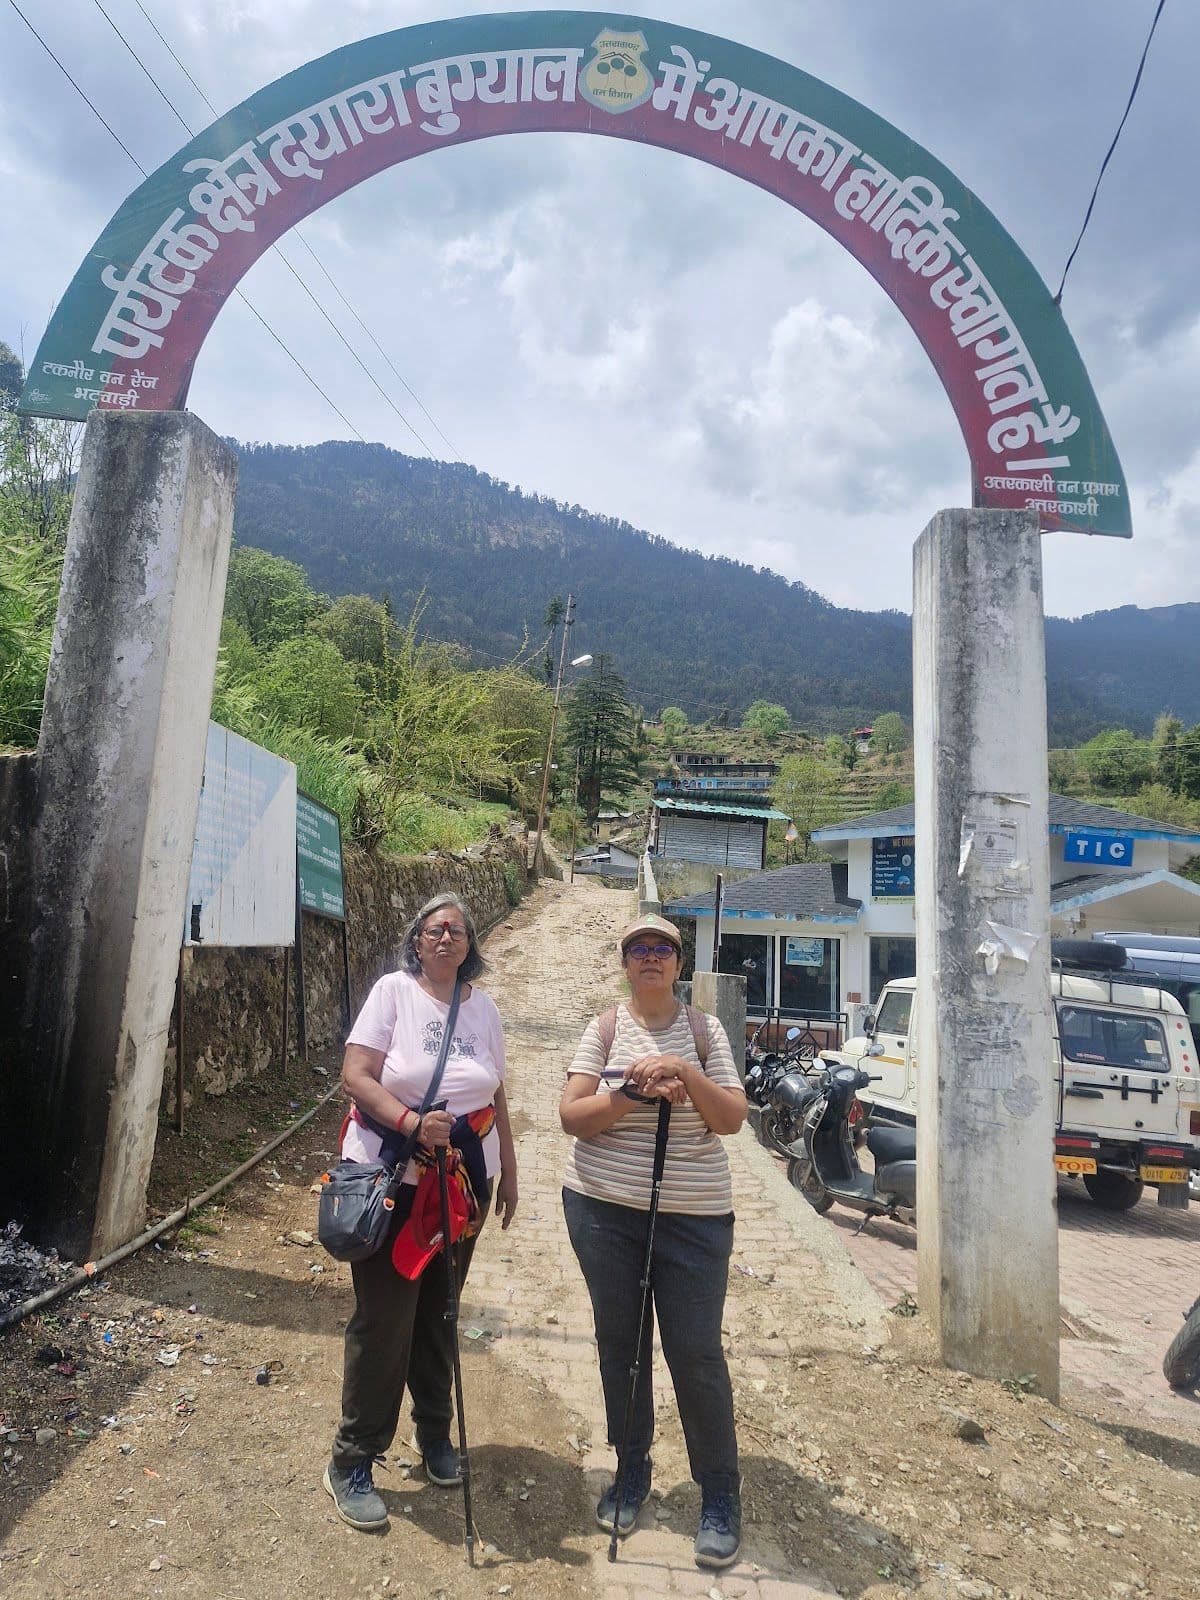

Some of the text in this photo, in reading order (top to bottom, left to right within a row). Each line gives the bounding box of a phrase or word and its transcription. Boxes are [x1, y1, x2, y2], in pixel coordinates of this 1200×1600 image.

[91, 208, 219, 359] पर्यटक
[182, 141, 282, 233] क्षेत्र
[256, 69, 412, 180] दयारा
[409, 47, 584, 135] बुग्याल
[652, 45, 711, 121] में
[694, 78, 862, 192] आपका
[834, 153, 967, 277] हार्दिक
[930, 254, 1050, 414] स्वागत
[100, 371, 125, 386] वन
[131, 369, 159, 389] रेंज
[1057, 480, 1080, 494] वन
[1076, 840, 1125, 859] TIC
[1056, 1160, 1095, 1172] TOP
